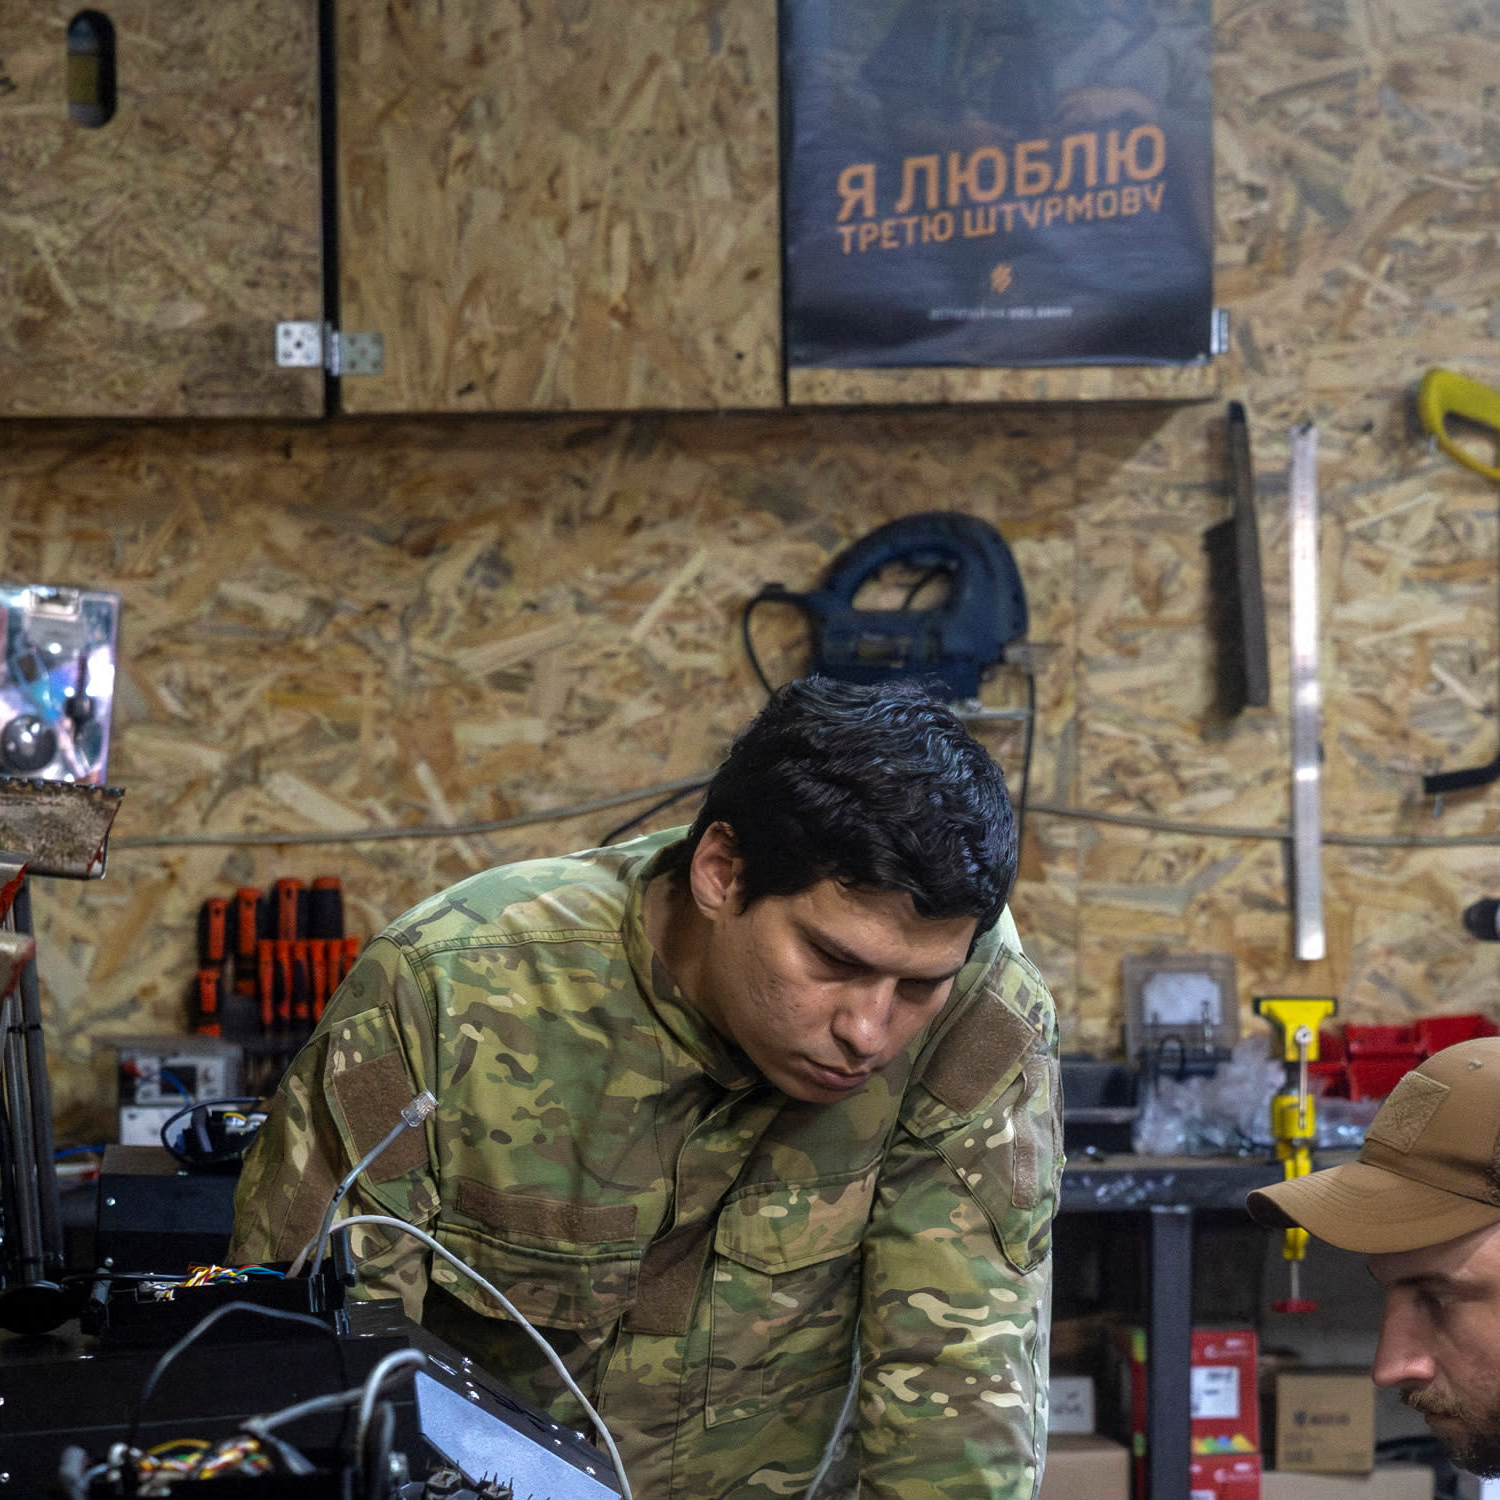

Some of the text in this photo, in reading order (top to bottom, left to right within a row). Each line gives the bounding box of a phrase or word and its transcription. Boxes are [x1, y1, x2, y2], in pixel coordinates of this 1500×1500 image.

[836, 123, 1167, 222] Я ЛЮБЛЮ
[836, 182, 1167, 254] ТРЕТЮ ШТУРМОВУ
